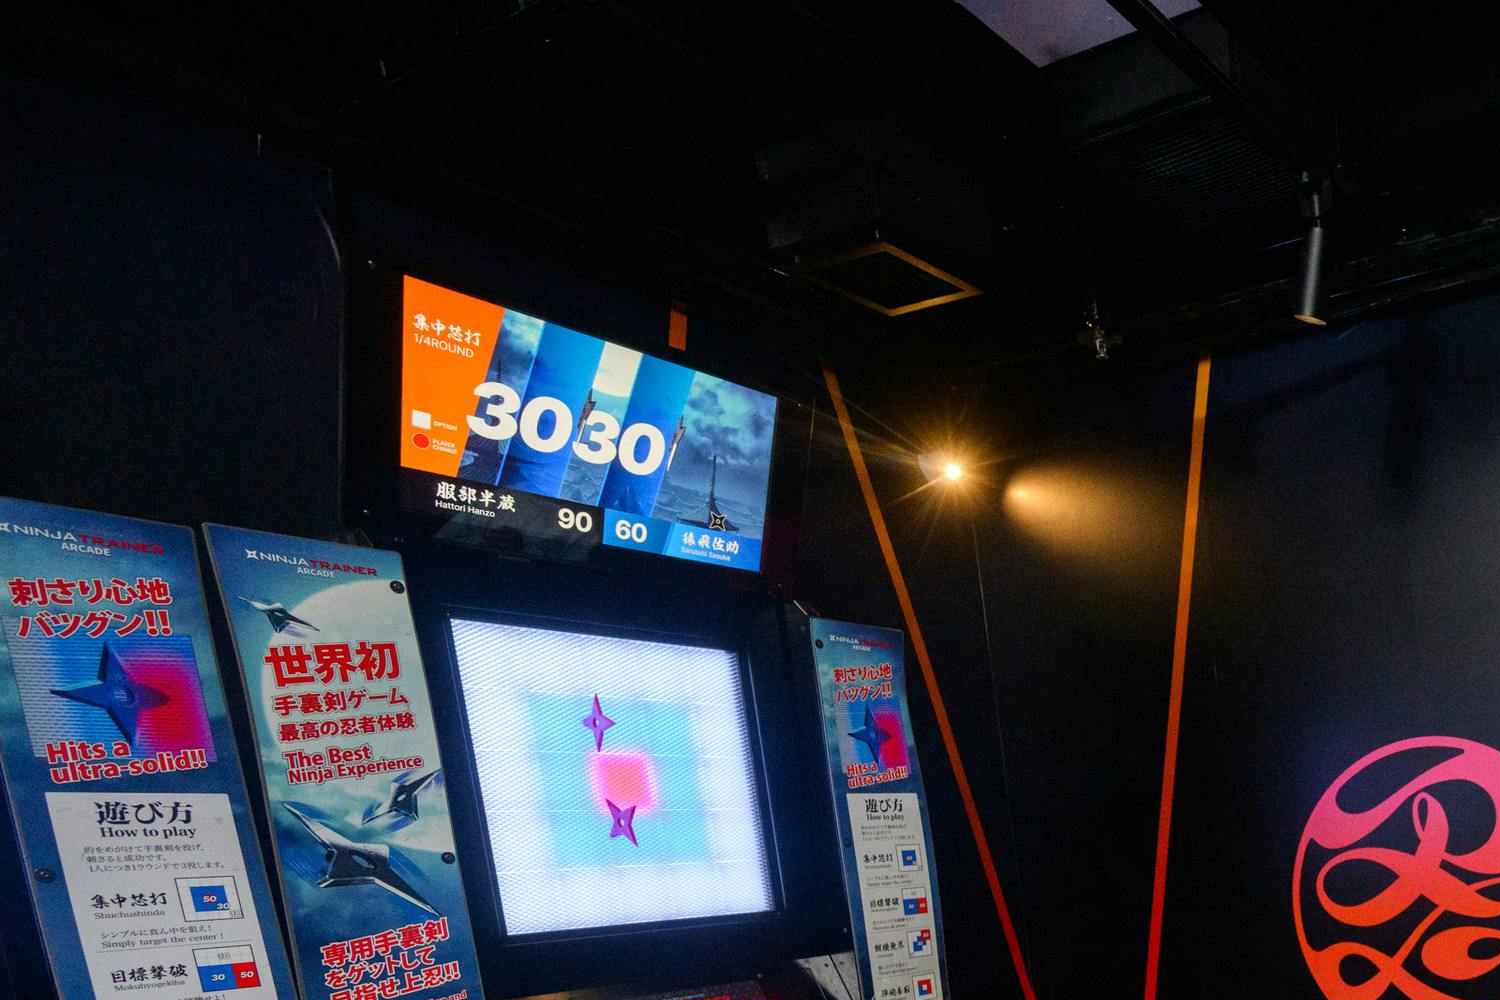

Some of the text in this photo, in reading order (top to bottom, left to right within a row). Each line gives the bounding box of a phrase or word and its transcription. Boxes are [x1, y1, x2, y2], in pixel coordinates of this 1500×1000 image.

[433, 421, 458, 431] OPTION
[466, 382, 666, 476] 30 30
[433, 439, 456, 448] PLAYER
[433, 444, 458, 455] CHANGE
[436, 481, 516, 513] 服部半蔵
[435, 500, 496, 518] Hattori Hanzo
[558, 508, 592, 533] 90
[615, 519, 647, 543] 60
[61, 542, 111, 556] ARCADE
[708, 552, 731, 561] Sasuke
[297, 567, 336, 579] ARCADE
[8, 578, 172, 607] 刺さり心地
[17, 610, 172, 638] バツグン!!
[264, 641, 401, 687] 世界初
[833, 663, 892, 684] 刺さり心地
[273, 687, 409, 717] 手裏剣ゲーム
[278, 712, 415, 744] 最高の忍者体験
[46, 741, 130, 765] Hits a
[284, 744, 372, 770] The Best
[50, 749, 208, 784] ultra-solid!!
[288, 755, 424, 785] Ninja Experience
[847, 762, 878, 776] Hits a
[95, 801, 193, 825] 遊び方
[865, 798, 903, 813] 遊び方
[867, 813, 881, 821] How
[891, 813, 904, 822] play
[100, 827, 197, 839] How to play
[91, 892, 167, 909] 集中芯打
[94, 909, 165, 919] Shuchushinda
[102, 938, 136, 949] Simply
[140, 938, 167, 947] target
[320, 916, 450, 967] 専用手裏剣
[110, 964, 189, 983] 目標撃破
[325, 945, 436, 989] をゲットして
